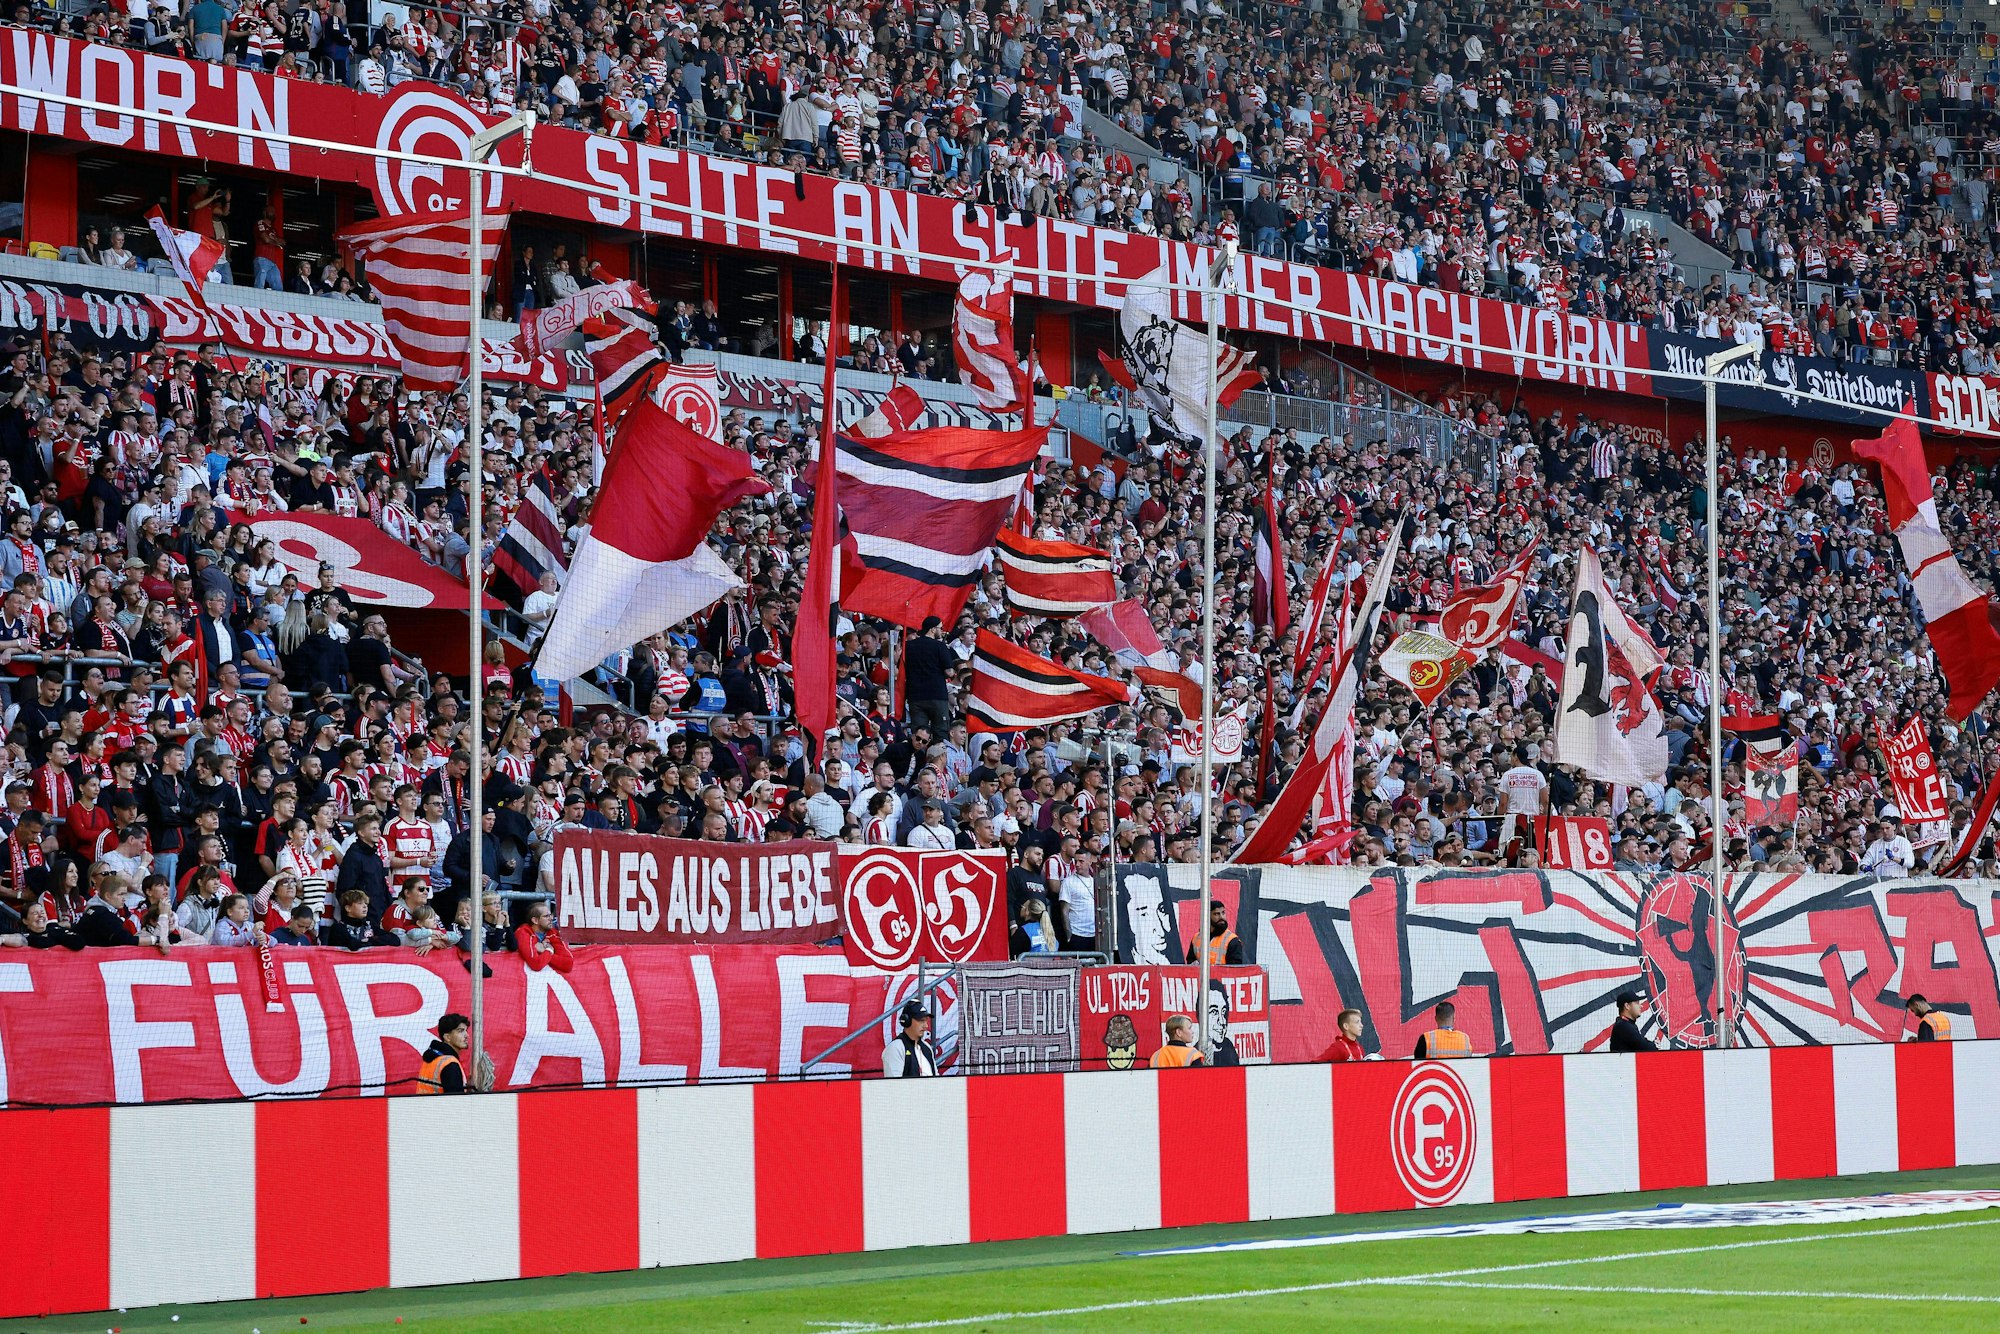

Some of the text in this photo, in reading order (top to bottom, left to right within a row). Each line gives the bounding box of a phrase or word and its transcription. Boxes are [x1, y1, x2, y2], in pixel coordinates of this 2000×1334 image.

[585, 134, 799, 255] SEITE
[833, 182, 920, 275] AN
[952, 200, 1129, 311] SEITE
[1159, 238, 1325, 341] IMMER
[1346, 273, 1482, 368] NACH
[1714, 358, 1767, 390] arde
[1935, 373, 1990, 431] SCD
[559, 847, 838, 935] ALLES AUS LIEBE
[891, 914, 911, 942] 95
[98, 960, 453, 1103] FÜR
[508, 955, 852, 1089] ALLE
[970, 988, 1067, 1038] VECCHIO
[1234, 1032, 1266, 1058] STAND
[1433, 1145, 1455, 1169] 95
